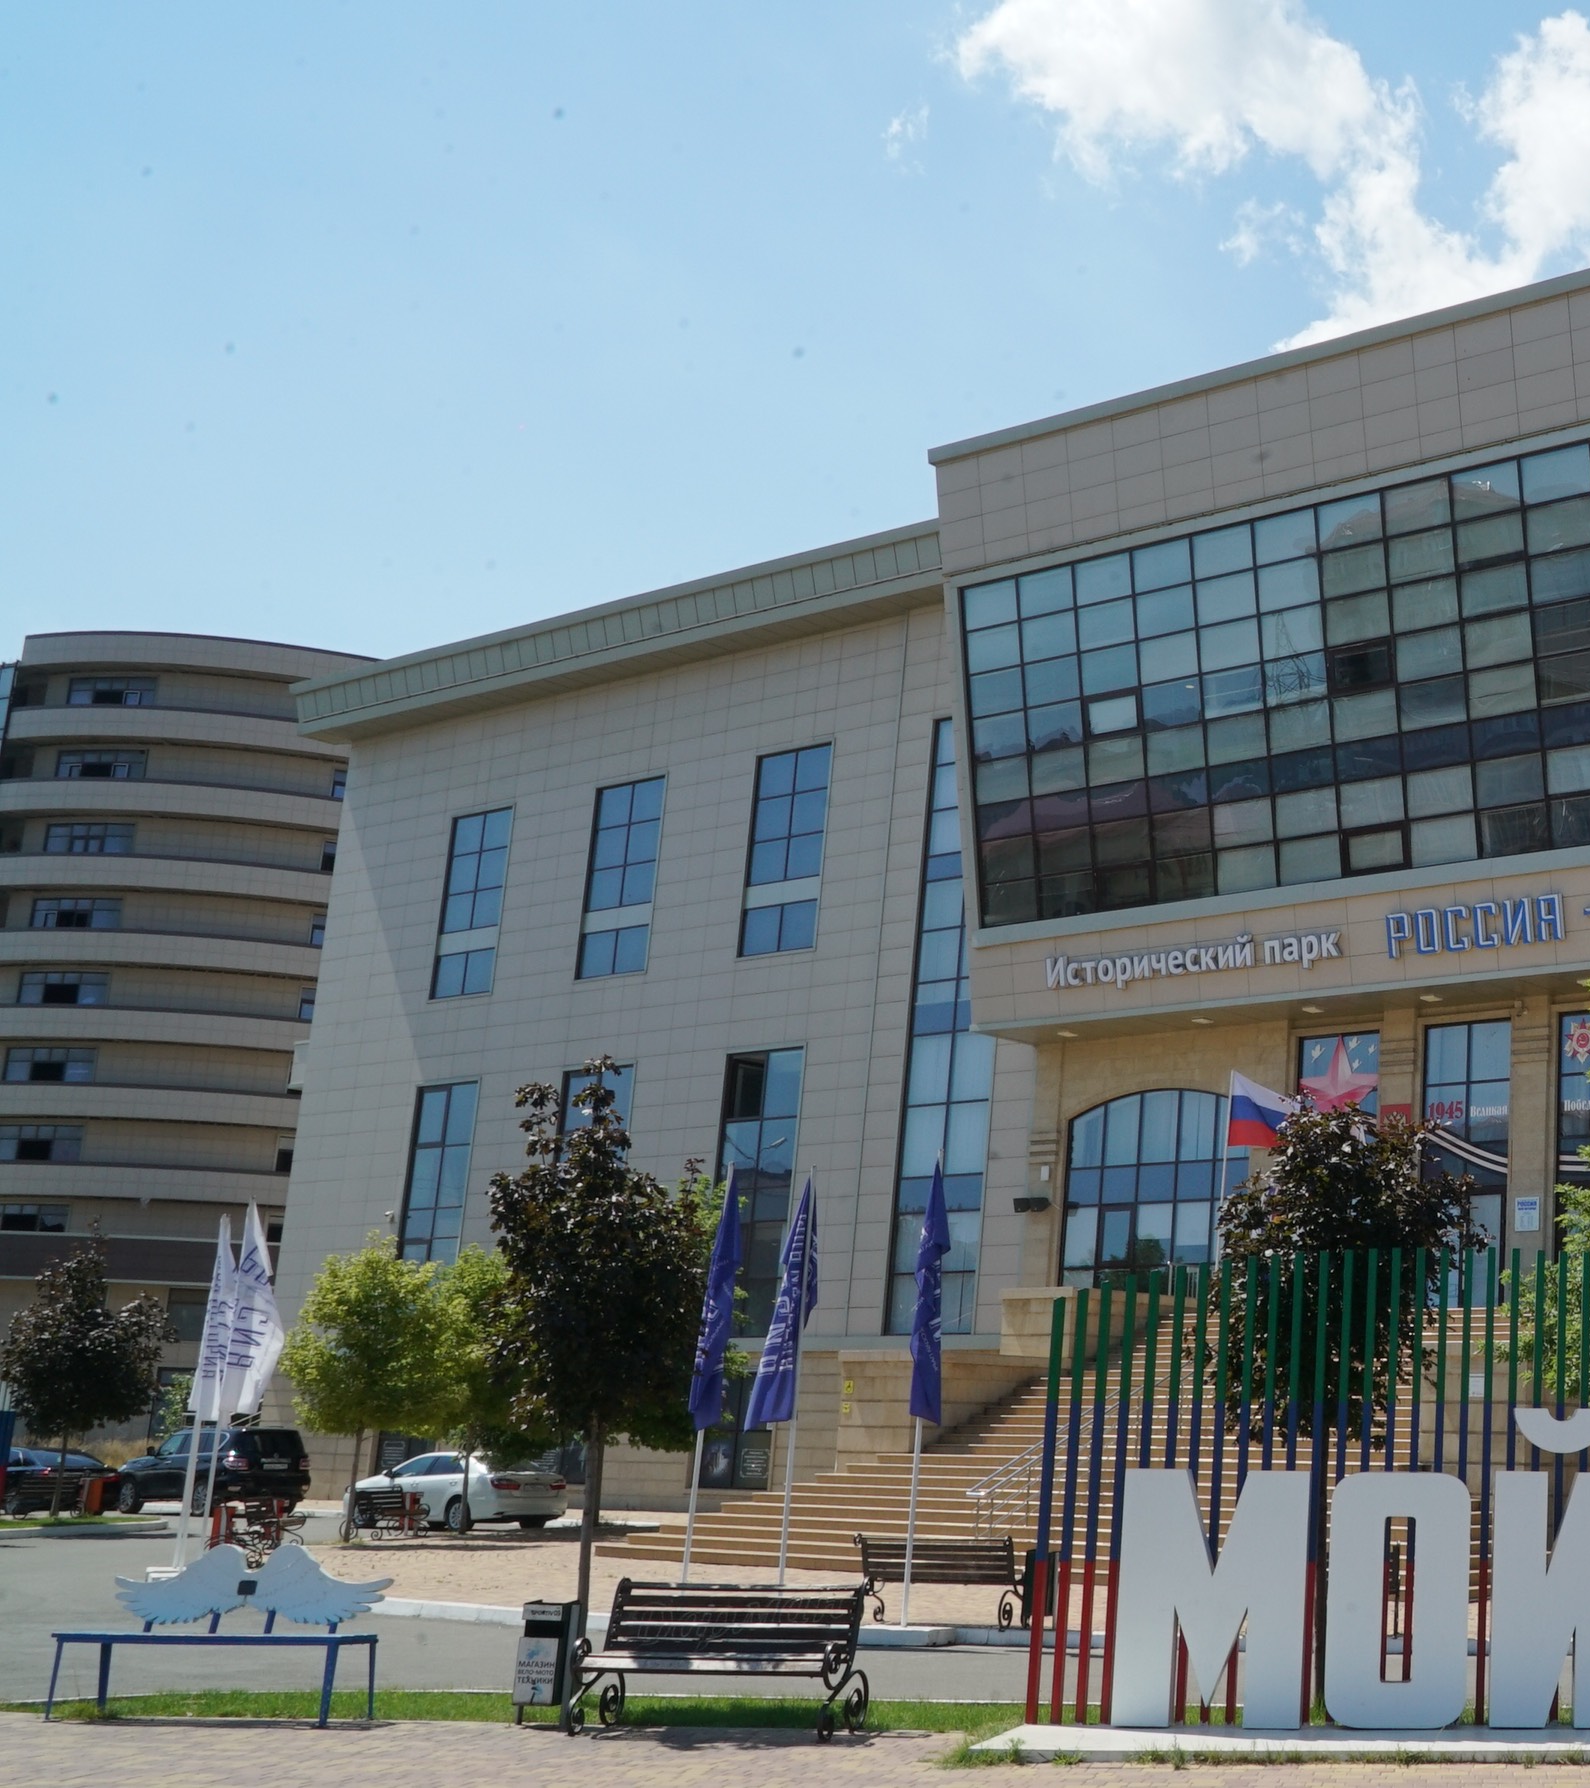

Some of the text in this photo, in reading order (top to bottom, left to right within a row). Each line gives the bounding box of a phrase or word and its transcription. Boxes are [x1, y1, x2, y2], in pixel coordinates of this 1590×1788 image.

[1385, 892, 1567, 960] РОССИЯ
[1046, 930, 1344, 990] Исторический парк
[1428, 1100, 1463, 1121] 1945
[1469, 1104, 1508, 1118] Великая
[518, 1660, 555, 1669] МАГАЗИН
